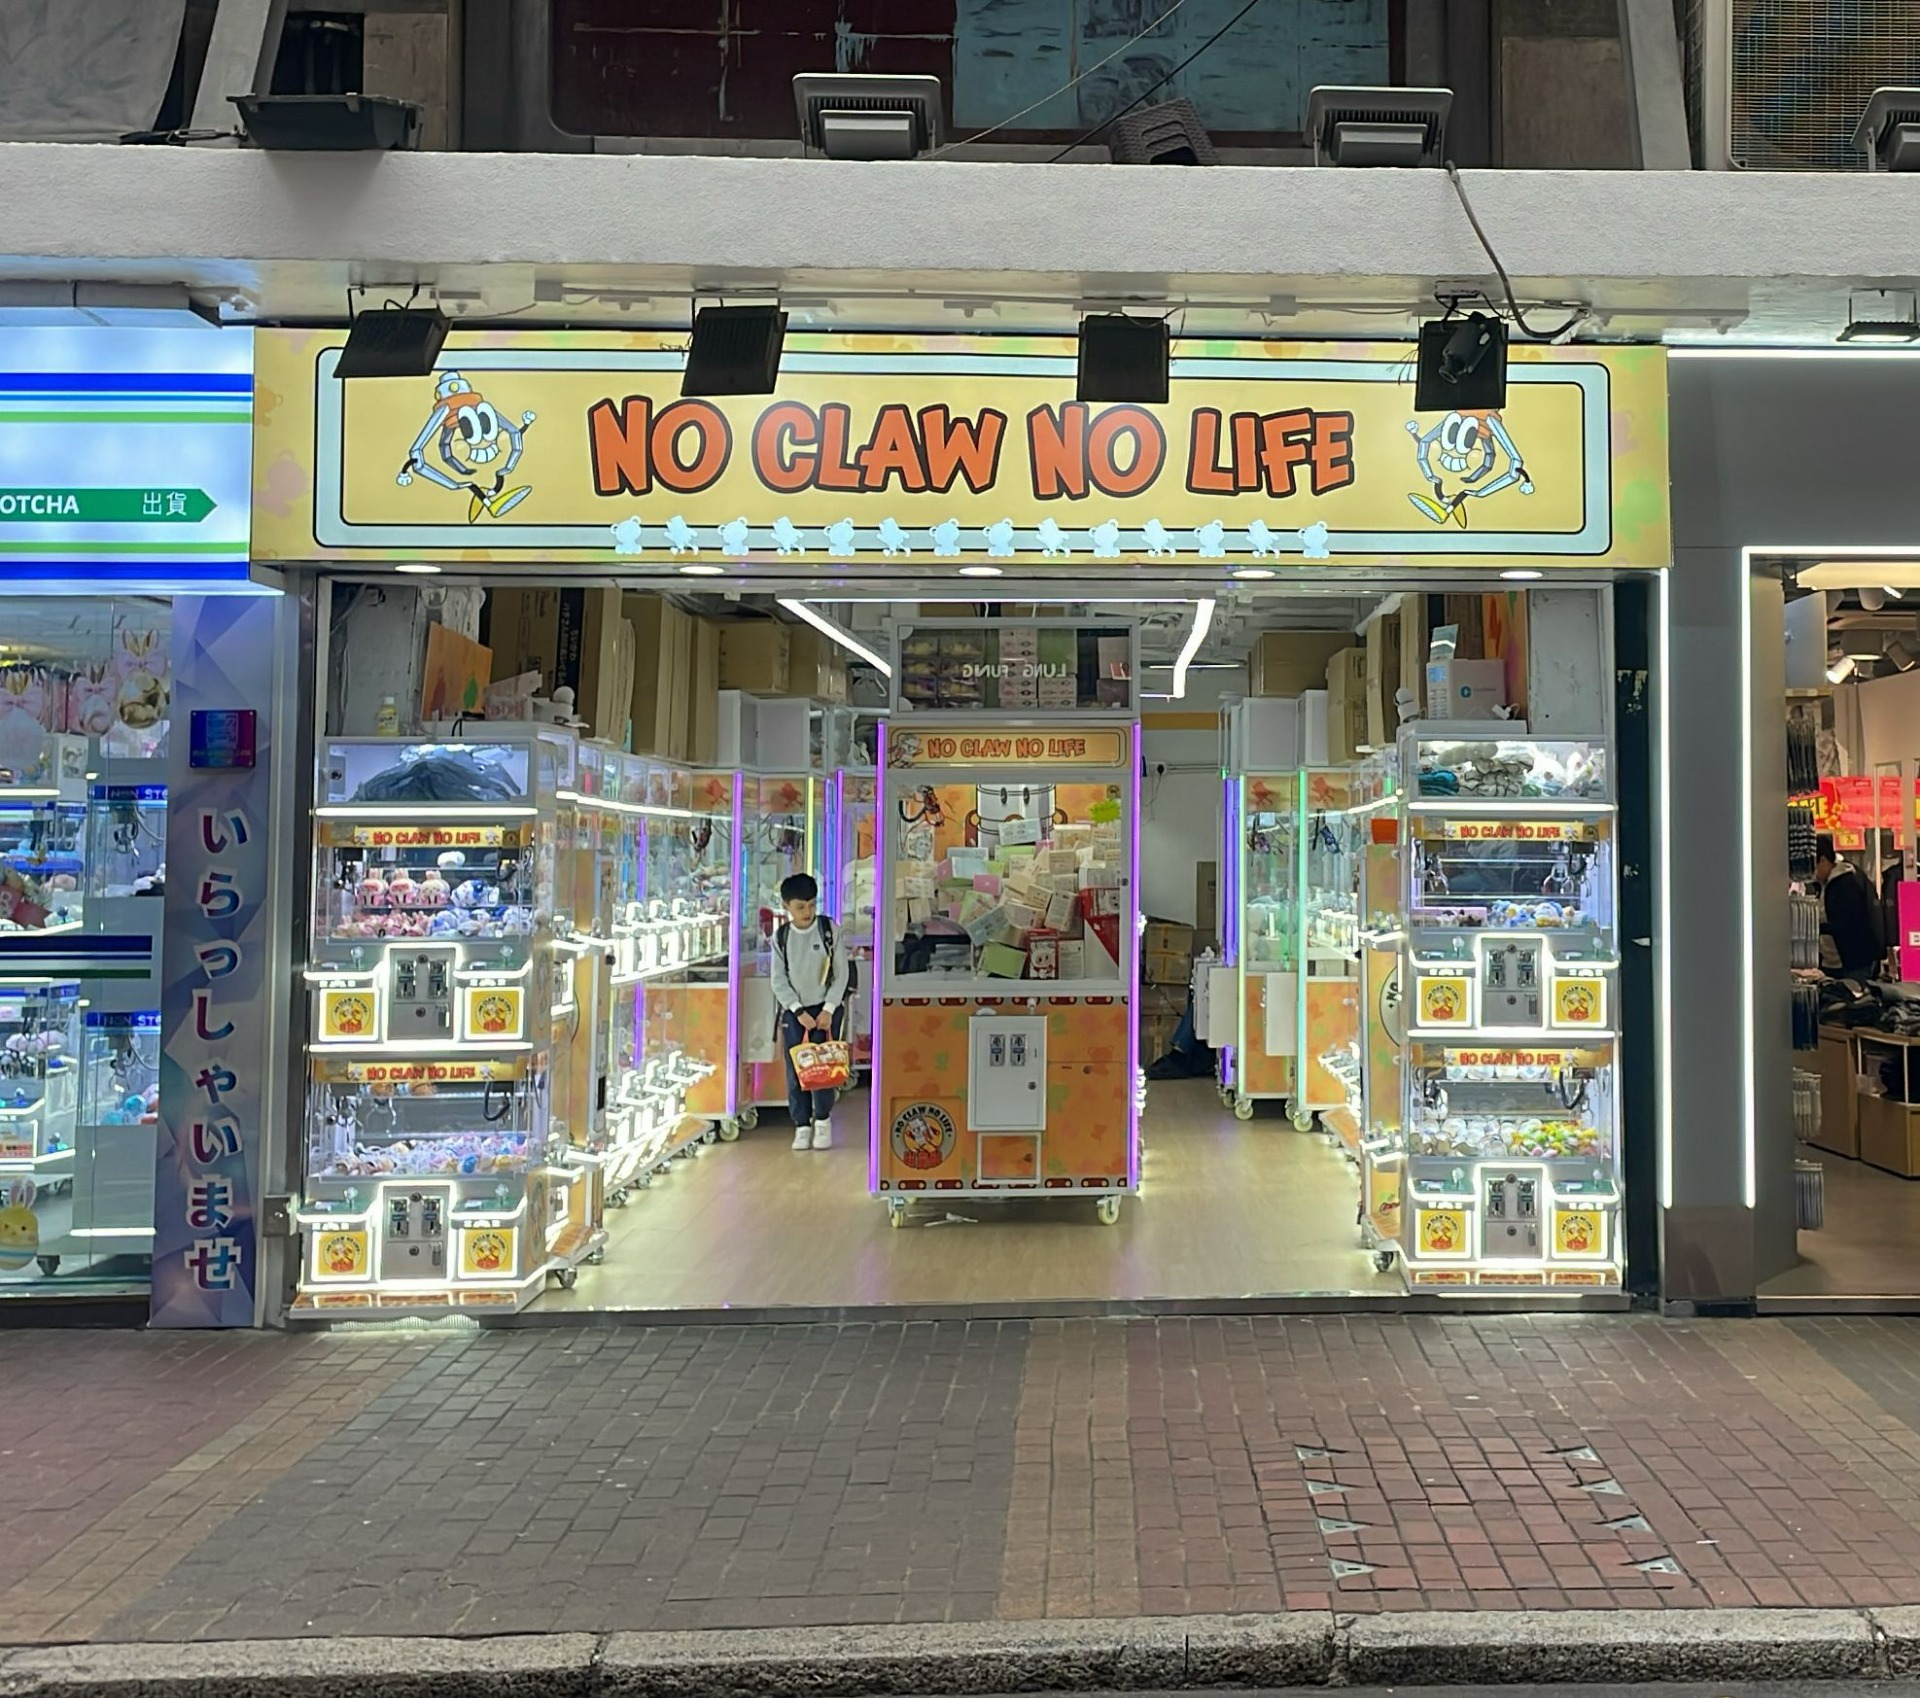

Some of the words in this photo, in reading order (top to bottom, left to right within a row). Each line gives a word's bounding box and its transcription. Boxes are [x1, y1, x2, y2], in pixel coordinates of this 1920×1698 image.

[589, 399, 732, 496] NO
[752, 402, 1005, 493] CLAW
[1028, 404, 1166, 500] NO
[1187, 407, 1354, 496] LIFE
[142, 491, 187, 516] 出貨
[928, 738, 956, 759] NO
[960, 739, 1012, 758] CLAW
[1016, 739, 1044, 758] NO
[1049, 738, 1086, 757] LIFE
[373, 832, 393, 845] NO
[434, 831, 453, 845] NO
[1460, 826, 1479, 839] NO
[1516, 826, 1534, 838] NO
[185, 808, 249, 1289] いらっしゃいませ
[1460, 1053, 1479, 1065] NO
[1516, 1053, 1535, 1065] NO
[367, 1067, 387, 1080] NO
[428, 1067, 447, 1080] NO
